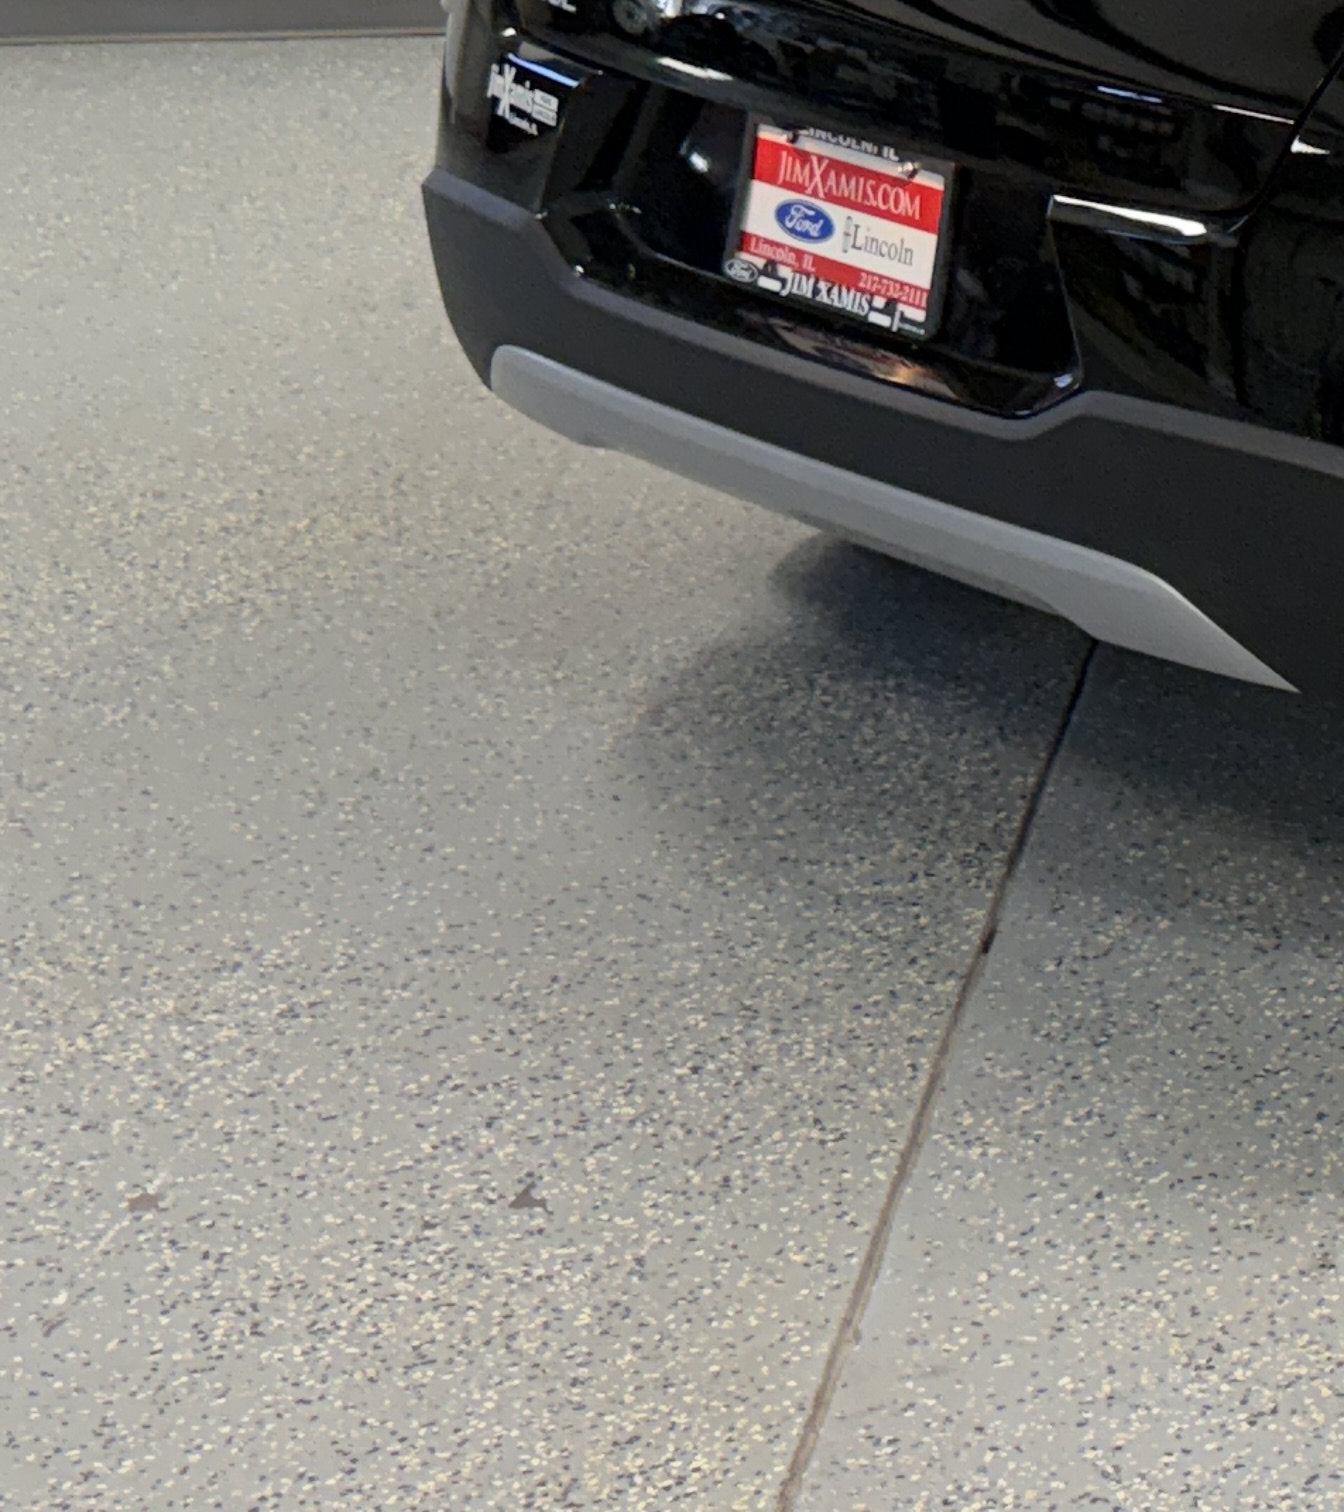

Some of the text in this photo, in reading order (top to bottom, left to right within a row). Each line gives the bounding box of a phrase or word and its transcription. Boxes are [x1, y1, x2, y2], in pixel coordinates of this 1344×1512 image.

[751, 236, 816, 272] Lincoln, IL
[784, 205, 914, 266] Ford Lincoln
[779, 273, 816, 296] JIM
[817, 281, 870, 316] XAMIS
